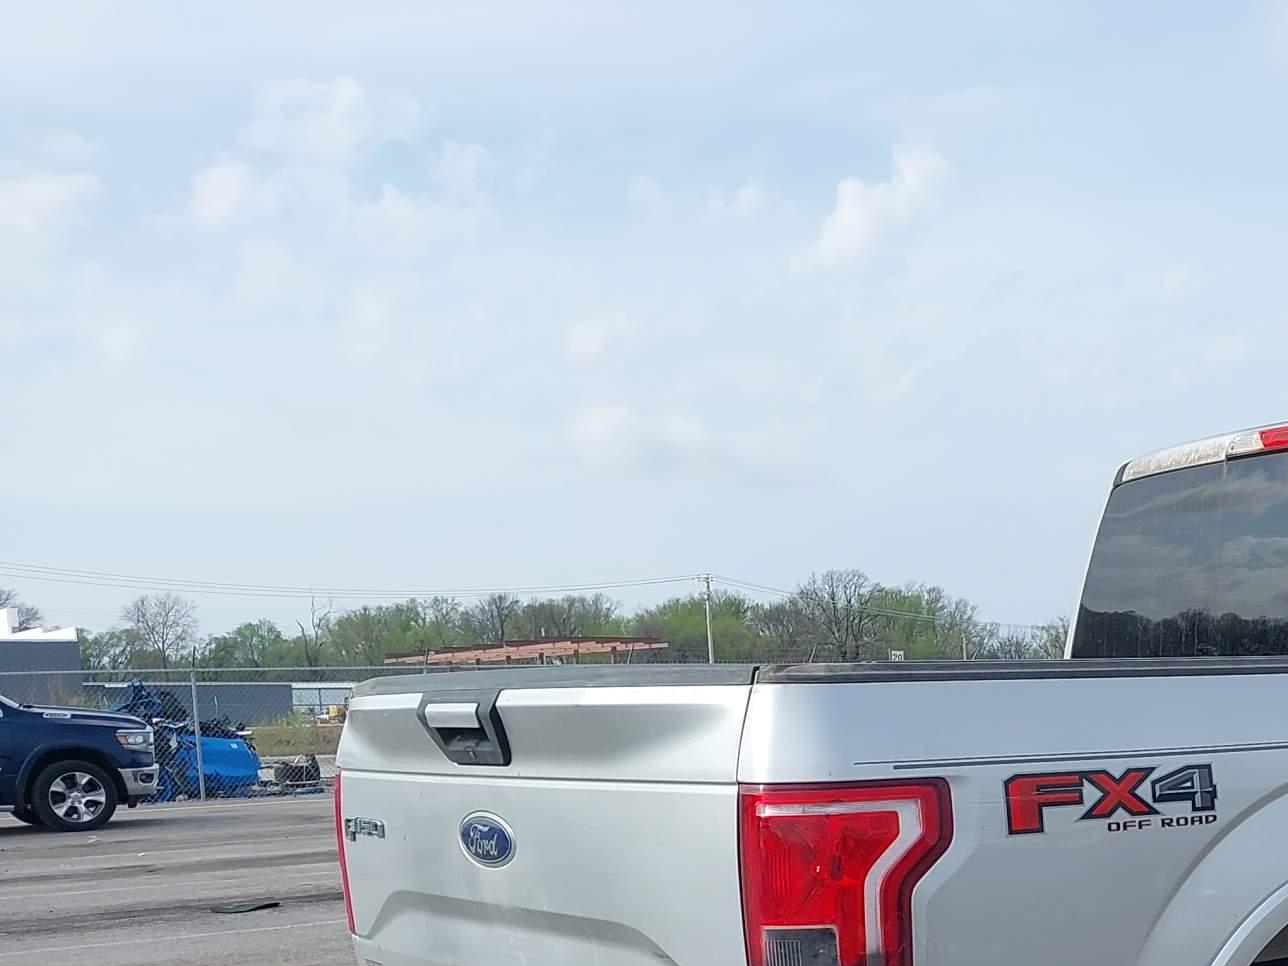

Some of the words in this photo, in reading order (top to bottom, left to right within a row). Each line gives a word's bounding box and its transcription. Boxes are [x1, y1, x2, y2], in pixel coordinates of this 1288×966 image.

[1004, 763, 1217, 835] FX4
[469, 823, 499, 856] Ford
[1107, 819, 1152, 832] OFF
[1160, 814, 1218, 829] ROAD
